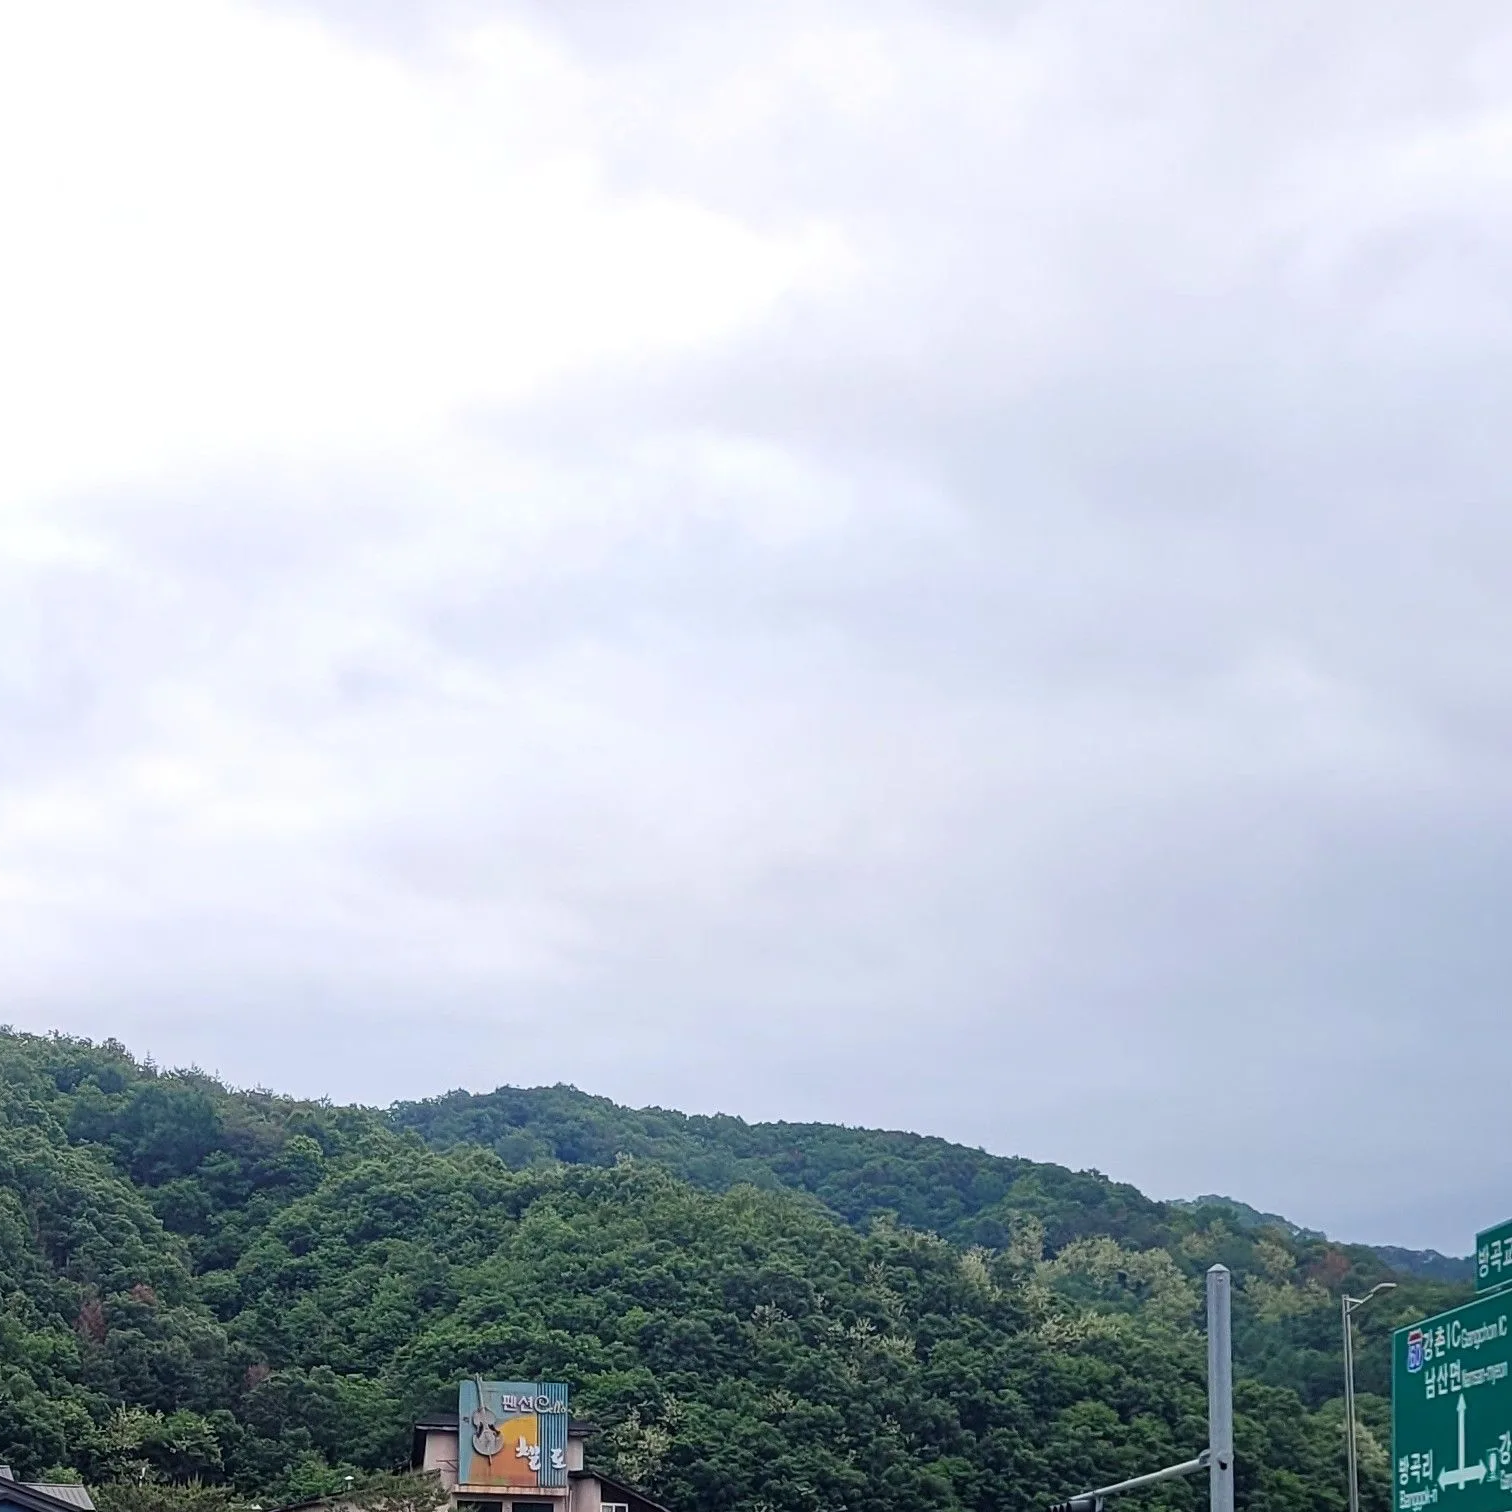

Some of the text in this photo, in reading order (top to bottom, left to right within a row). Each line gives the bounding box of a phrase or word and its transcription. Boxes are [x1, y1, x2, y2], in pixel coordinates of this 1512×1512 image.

[1423, 1326, 1446, 1361] 강촌
[1446, 1320, 1461, 1349] IC
[1424, 1359, 1462, 1400] 남산면
[502, 1394, 573, 1414] 펜션 Cello
[1398, 1449, 1433, 1486] 방곡리
